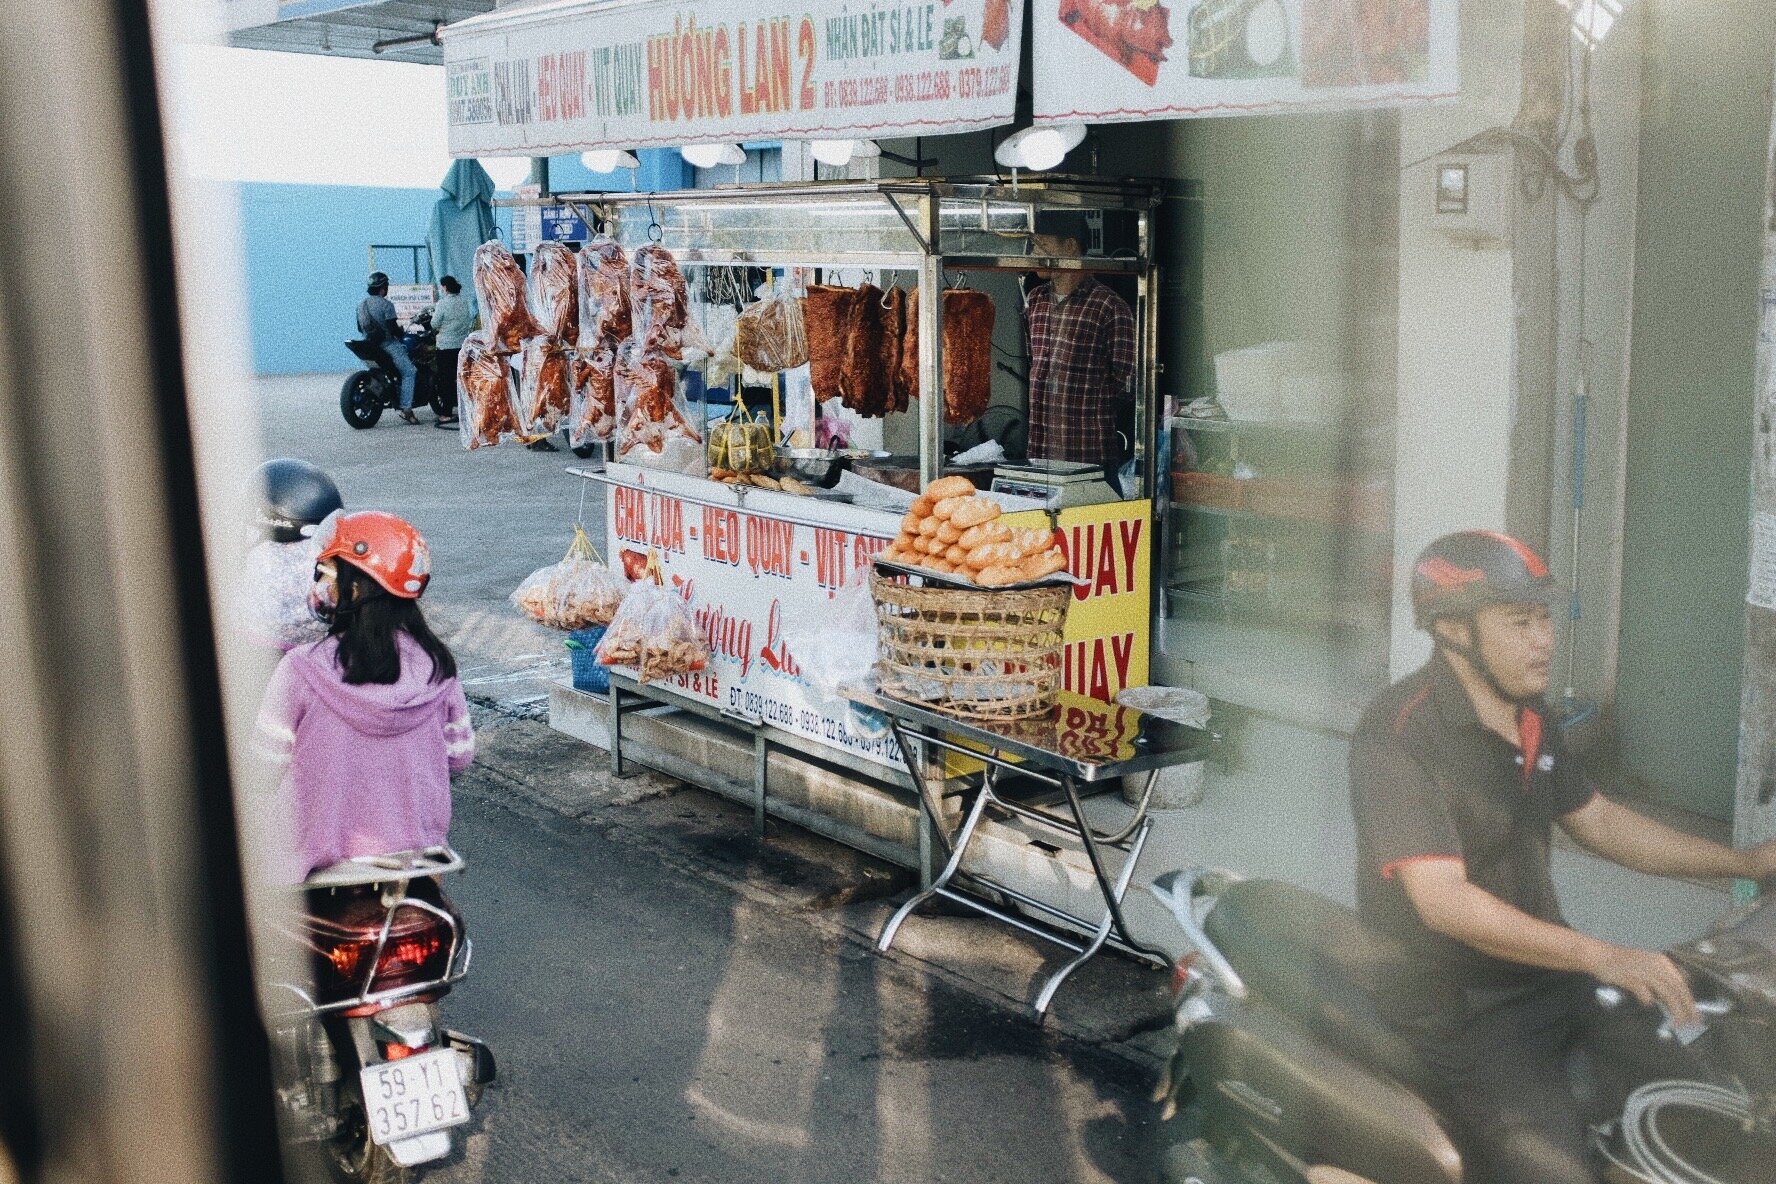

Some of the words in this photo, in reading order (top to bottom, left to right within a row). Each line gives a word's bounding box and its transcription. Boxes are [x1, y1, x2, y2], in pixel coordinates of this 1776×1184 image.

[538, 54, 557, 122] HEO
[737, 15, 790, 115] LAN
[796, 13, 817, 111] 2
[703, 505, 740, 567] HEO
[746, 514, 794, 579] QUAY
[692, 672, 704, 693] &
